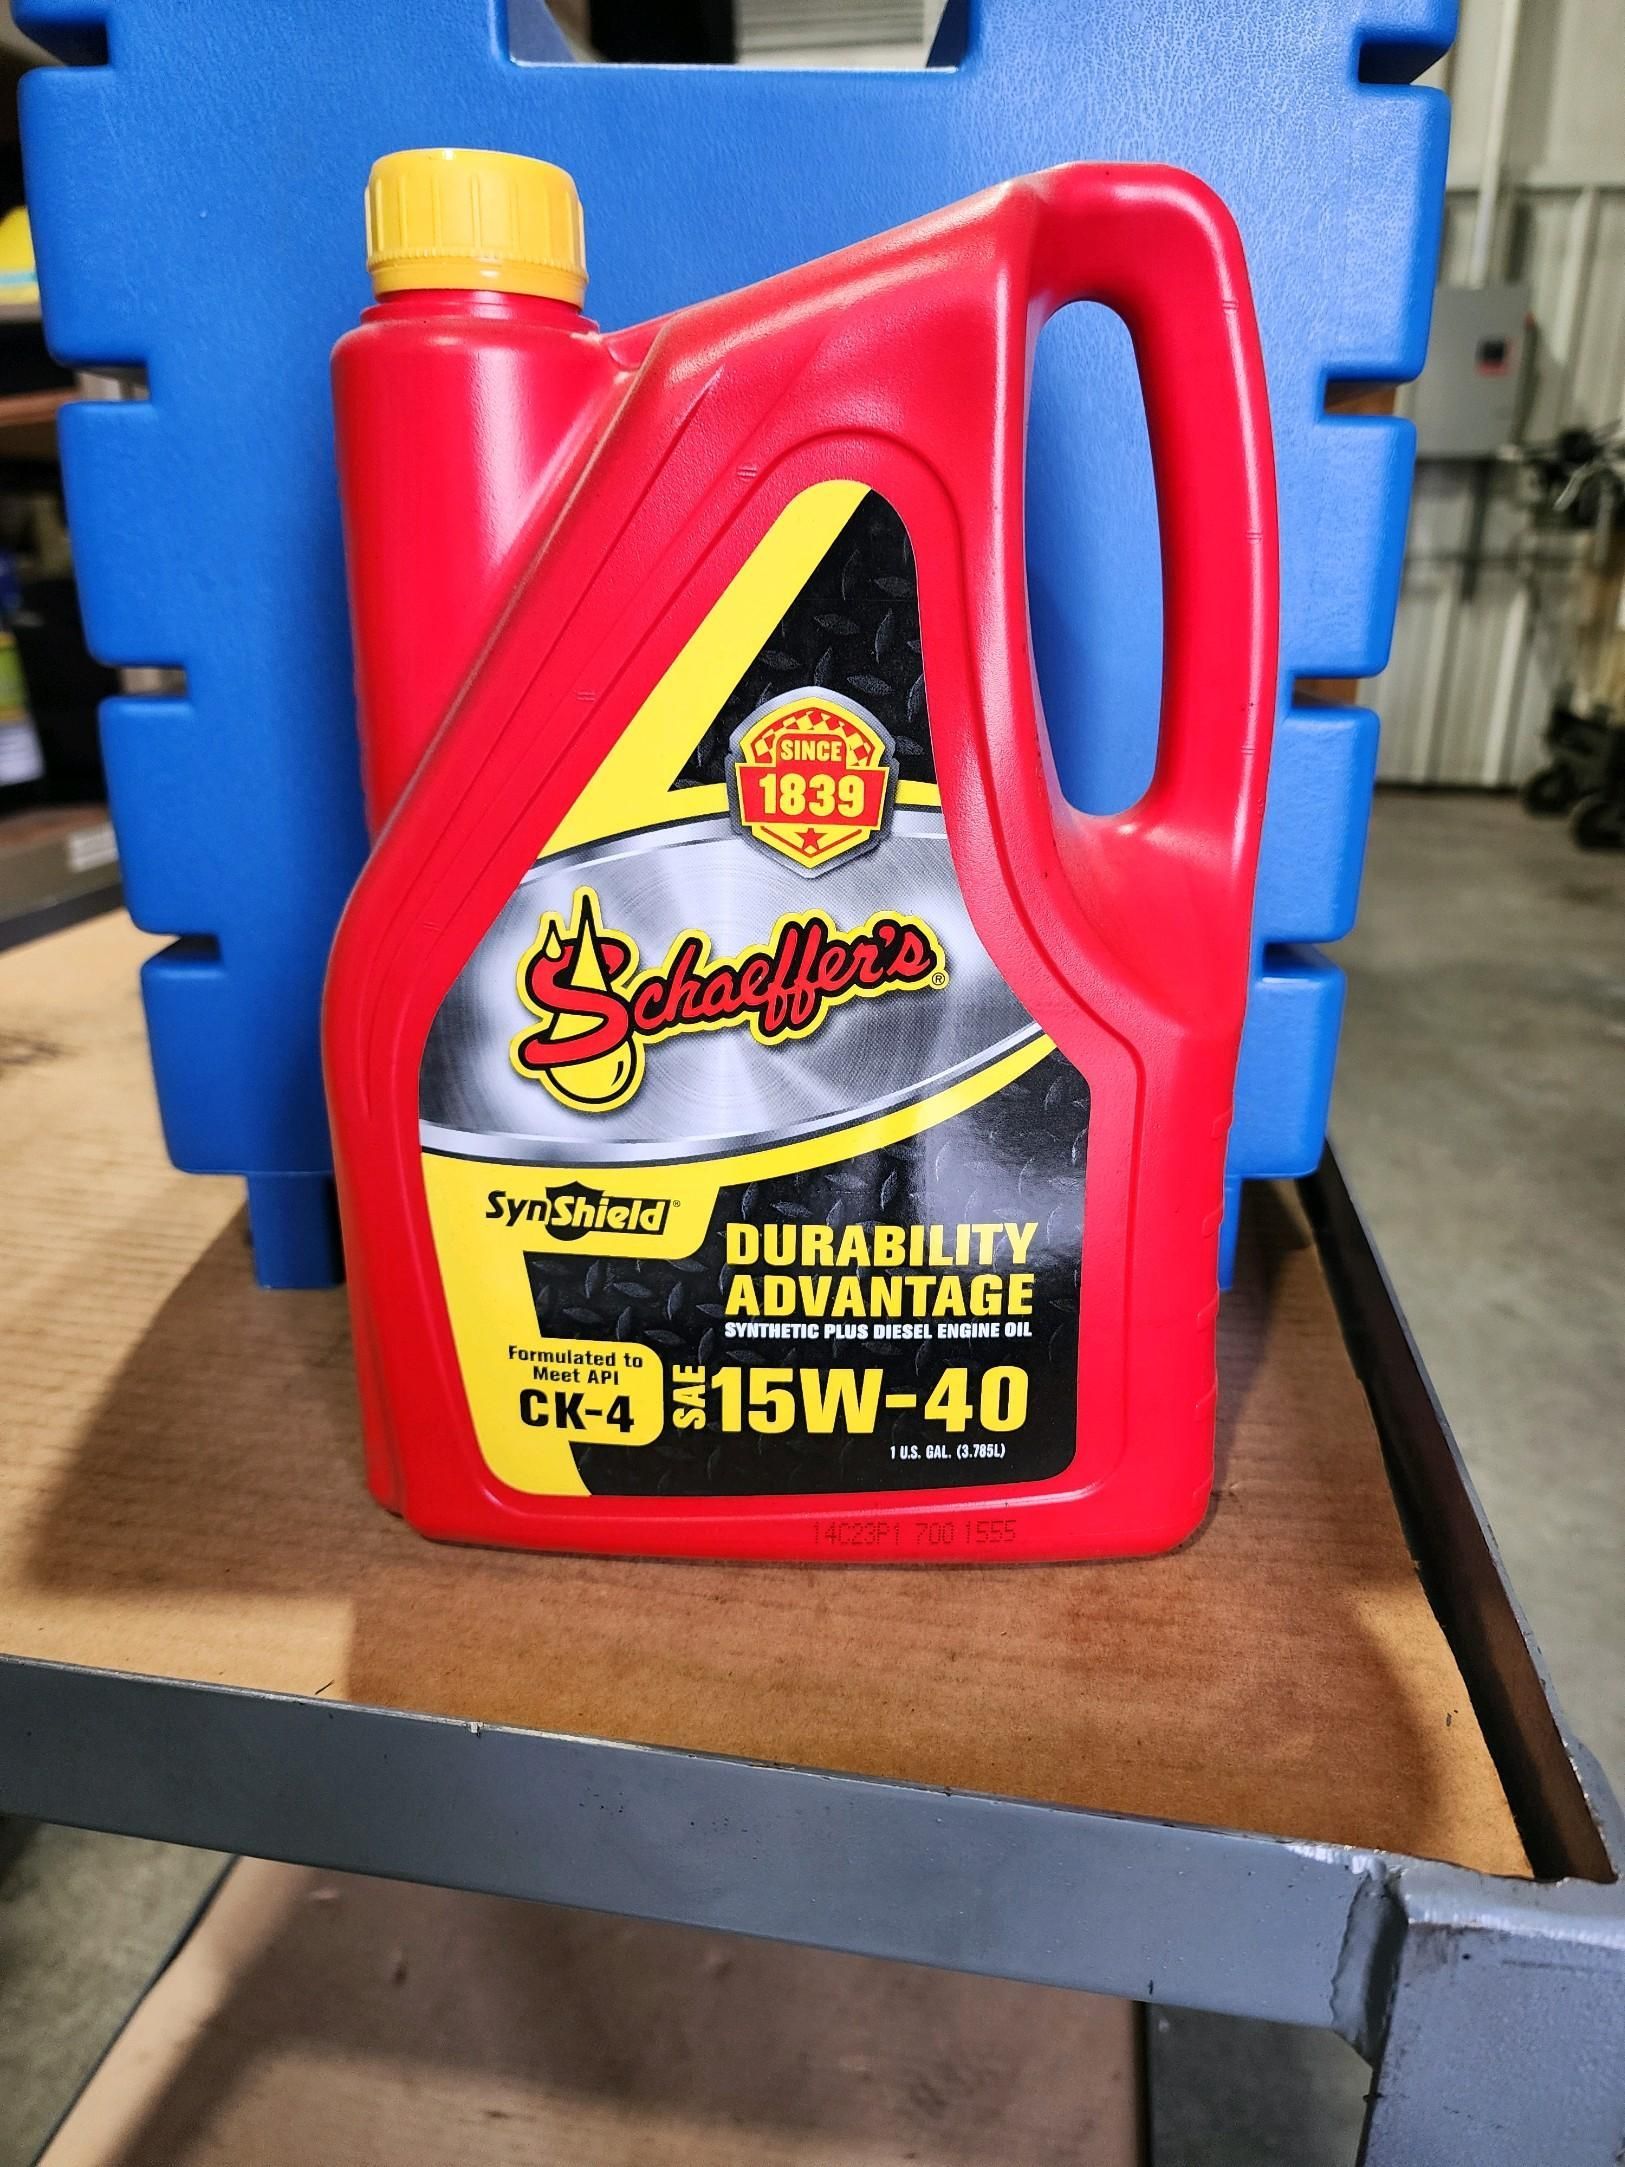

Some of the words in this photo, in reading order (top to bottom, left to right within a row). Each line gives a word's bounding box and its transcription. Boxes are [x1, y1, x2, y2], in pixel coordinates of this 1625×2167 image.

[780, 739, 842, 763] SINCE
[759, 773, 866, 818] 1839
[725, 1221, 1038, 1268] DURABILITY
[724, 1273, 1034, 1318] ADVANTAGE
[724, 1321, 820, 1340] SYNTHETIC
[824, 1322, 869, 1340] PLUS
[873, 1322, 933, 1340] DIESEL
[937, 1321, 1000, 1339] ENGINE
[1004, 1321, 1033, 1338] OIL
[508, 1344, 616, 1367] Formulated
[624, 1352, 644, 1369] to
[532, 1365, 581, 1384] Meet
[587, 1369, 620, 1386] API
[519, 1387, 636, 1434] CK-4
[672, 1364, 707, 1430] SAE
[710, 1365, 1029, 1435] 15W-40
[890, 1445, 896, 1460] 1
[899, 1445, 922, 1460] U.S.
[925, 1444, 952, 1460] GAL.
[956, 1442, 1006, 1460] (3.785L)
[915, 1521, 954, 1545] 700
[965, 1518, 1017, 1544] 1555
